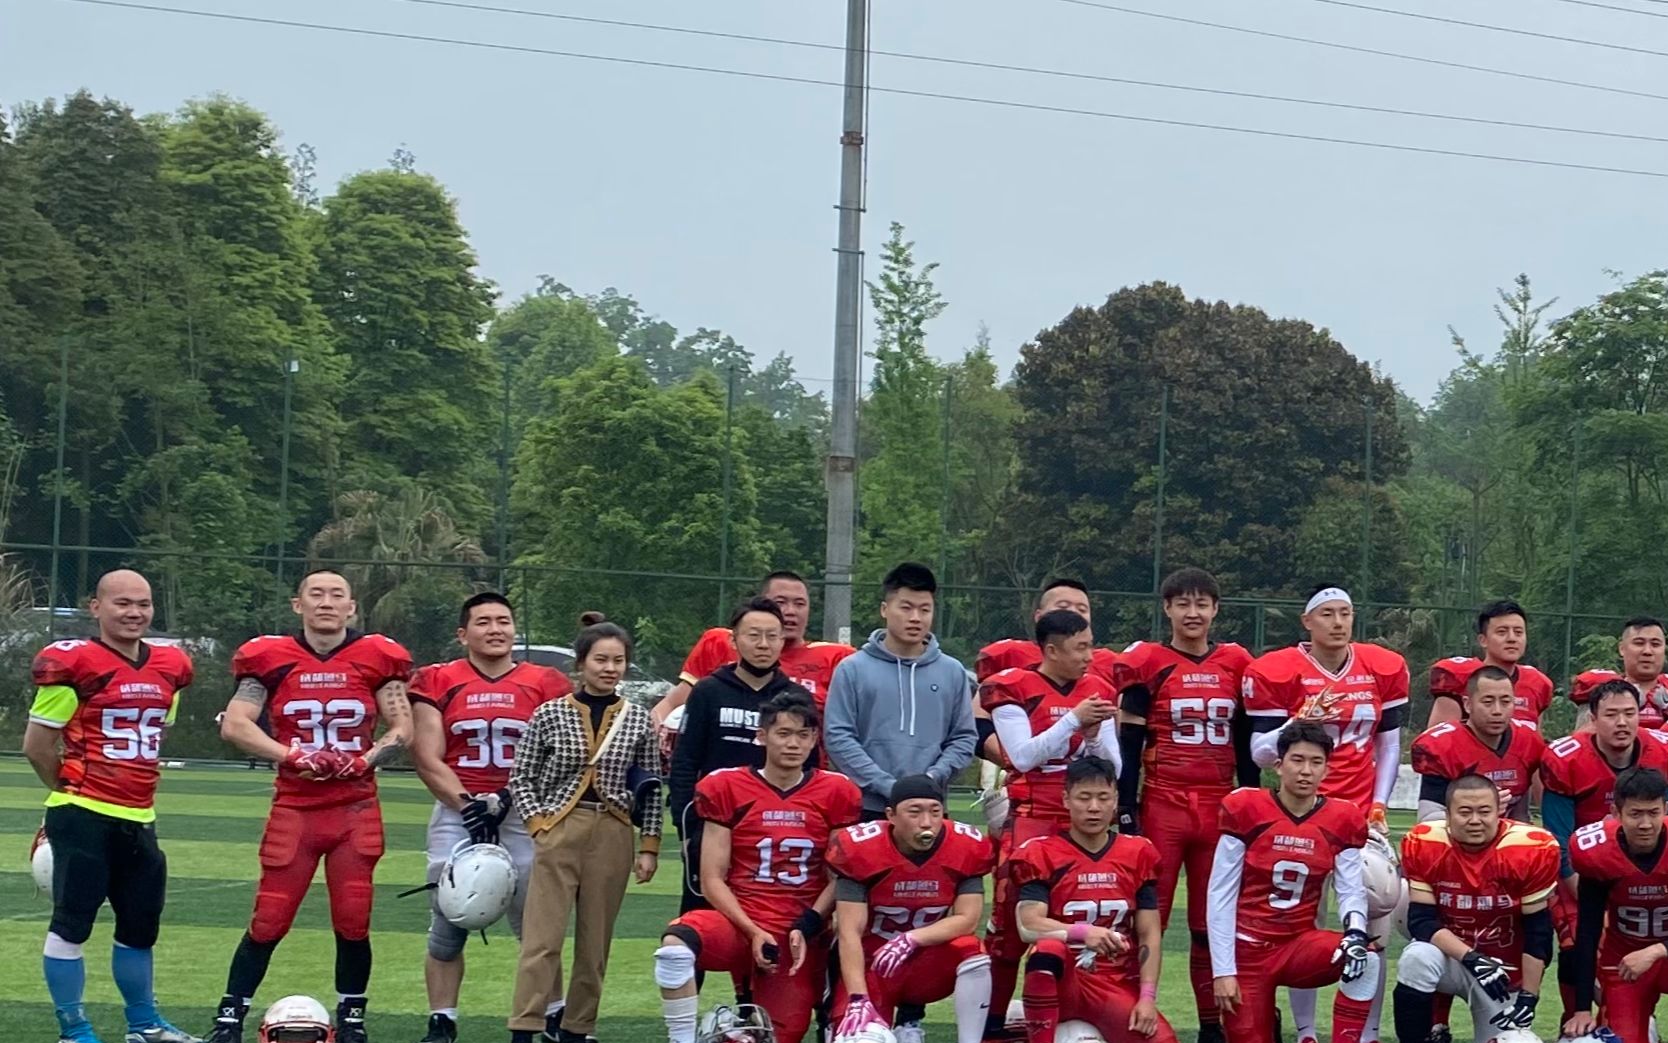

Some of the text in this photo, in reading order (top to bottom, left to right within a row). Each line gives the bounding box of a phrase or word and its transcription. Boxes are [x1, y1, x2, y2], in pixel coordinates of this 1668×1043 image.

[102, 708, 167, 760] 56
[283, 698, 366, 752] 32
[1171, 697, 1236, 746] 58
[755, 837, 816, 885] 13
[1268, 860, 1310, 910] 9
